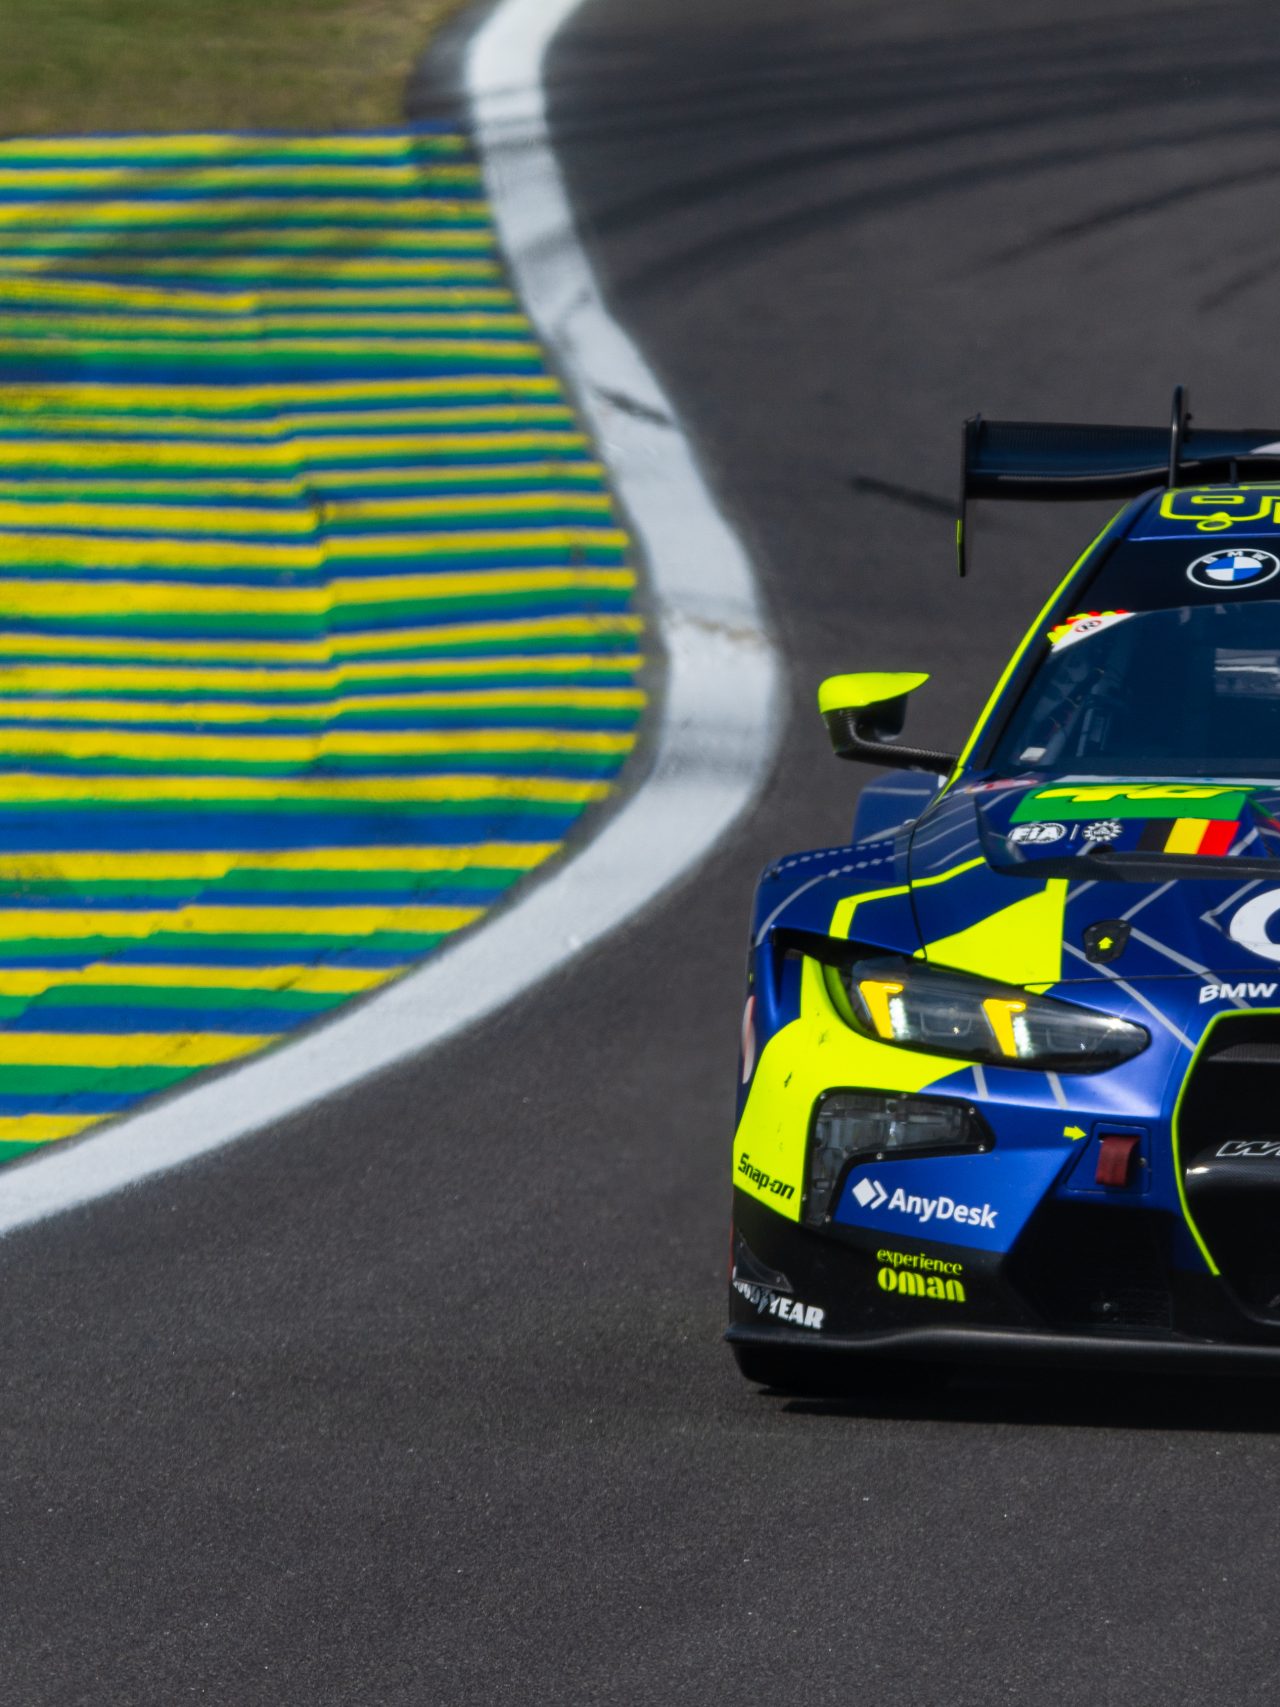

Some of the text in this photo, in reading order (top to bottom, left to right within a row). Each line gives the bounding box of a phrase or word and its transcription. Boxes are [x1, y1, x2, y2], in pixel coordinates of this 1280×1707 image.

[1010, 826, 1059, 842] FIA
[1199, 983, 1277, 1003] BMW
[738, 1153, 795, 1200] Snap-on
[888, 1188, 998, 1229] AnyDesk
[877, 1250, 963, 1276] experience
[877, 1267, 966, 1303] oman
